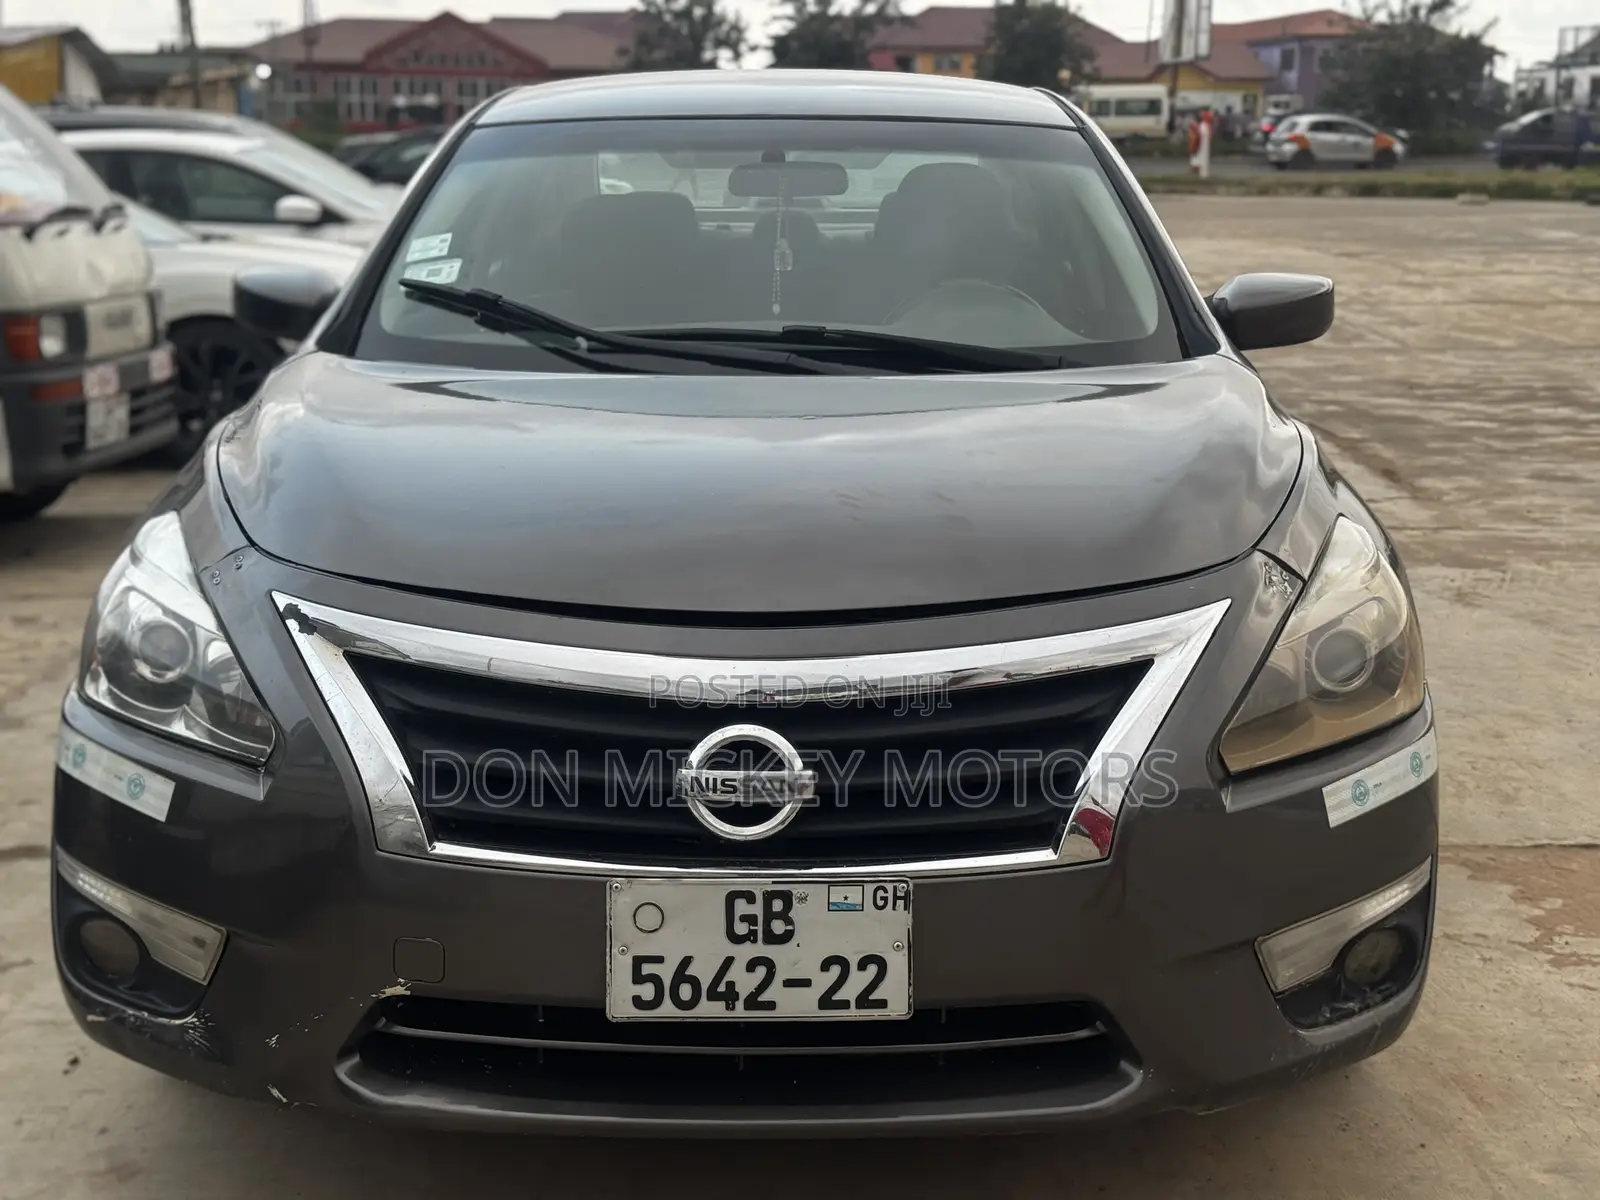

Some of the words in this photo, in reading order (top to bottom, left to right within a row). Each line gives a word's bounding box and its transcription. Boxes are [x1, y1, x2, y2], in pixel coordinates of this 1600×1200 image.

[725, 889, 795, 945] GB
[872, 885, 908, 911] GH
[631, 954, 888, 1011] 5642-22
